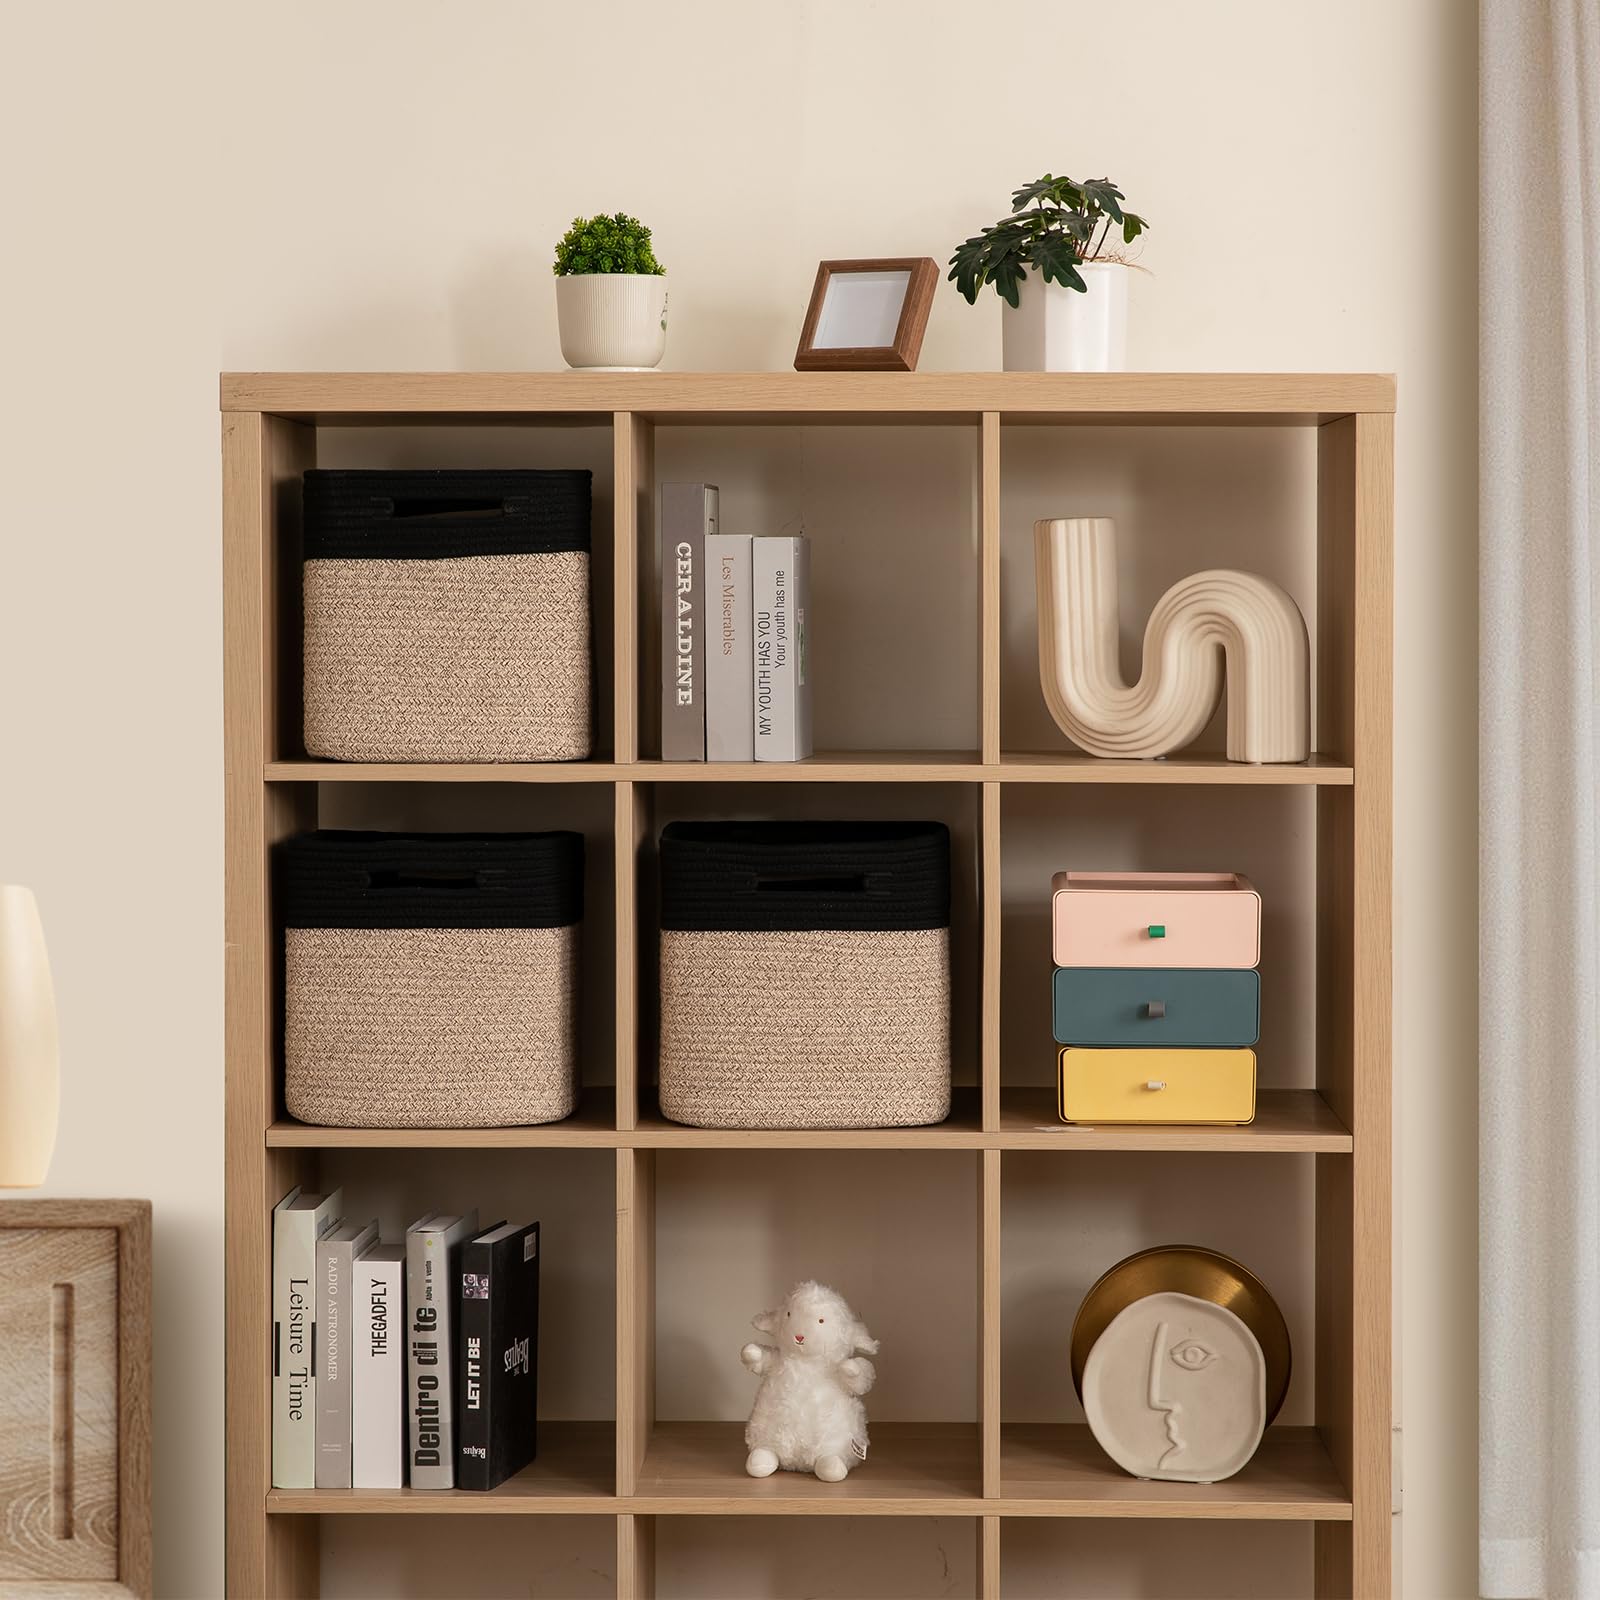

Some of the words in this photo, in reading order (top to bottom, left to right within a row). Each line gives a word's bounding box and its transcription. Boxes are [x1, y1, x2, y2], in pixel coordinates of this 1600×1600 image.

[721, 557, 734, 580] Les
[776, 570, 785, 587] me
[774, 589, 785, 609] has
[675, 541, 693, 706] CERALDINE
[722, 583, 736, 656] Miserables
[758, 611, 771, 638] YOU
[774, 611, 788, 641] youth
[758, 641, 771, 667] HAS
[774, 643, 786, 669] Your
[759, 670, 772, 713] YOUTH
[760, 716, 772, 736] MY
[327, 1257, 338, 1294] RADIO
[289, 1278, 309, 1355] Leisure
[371, 1278, 388, 1358] THEGADFLY
[413, 1307, 438, 1333] te
[327, 1298, 339, 1381] ASTRONOMER
[467, 1337, 481, 1358] BE
[413, 1342, 438, 1366] di
[467, 1361, 481, 1377] IT
[289, 1367, 308, 1421] Time
[467, 1379, 481, 1410] LET
[414, 1375, 441, 1467] Dentro
